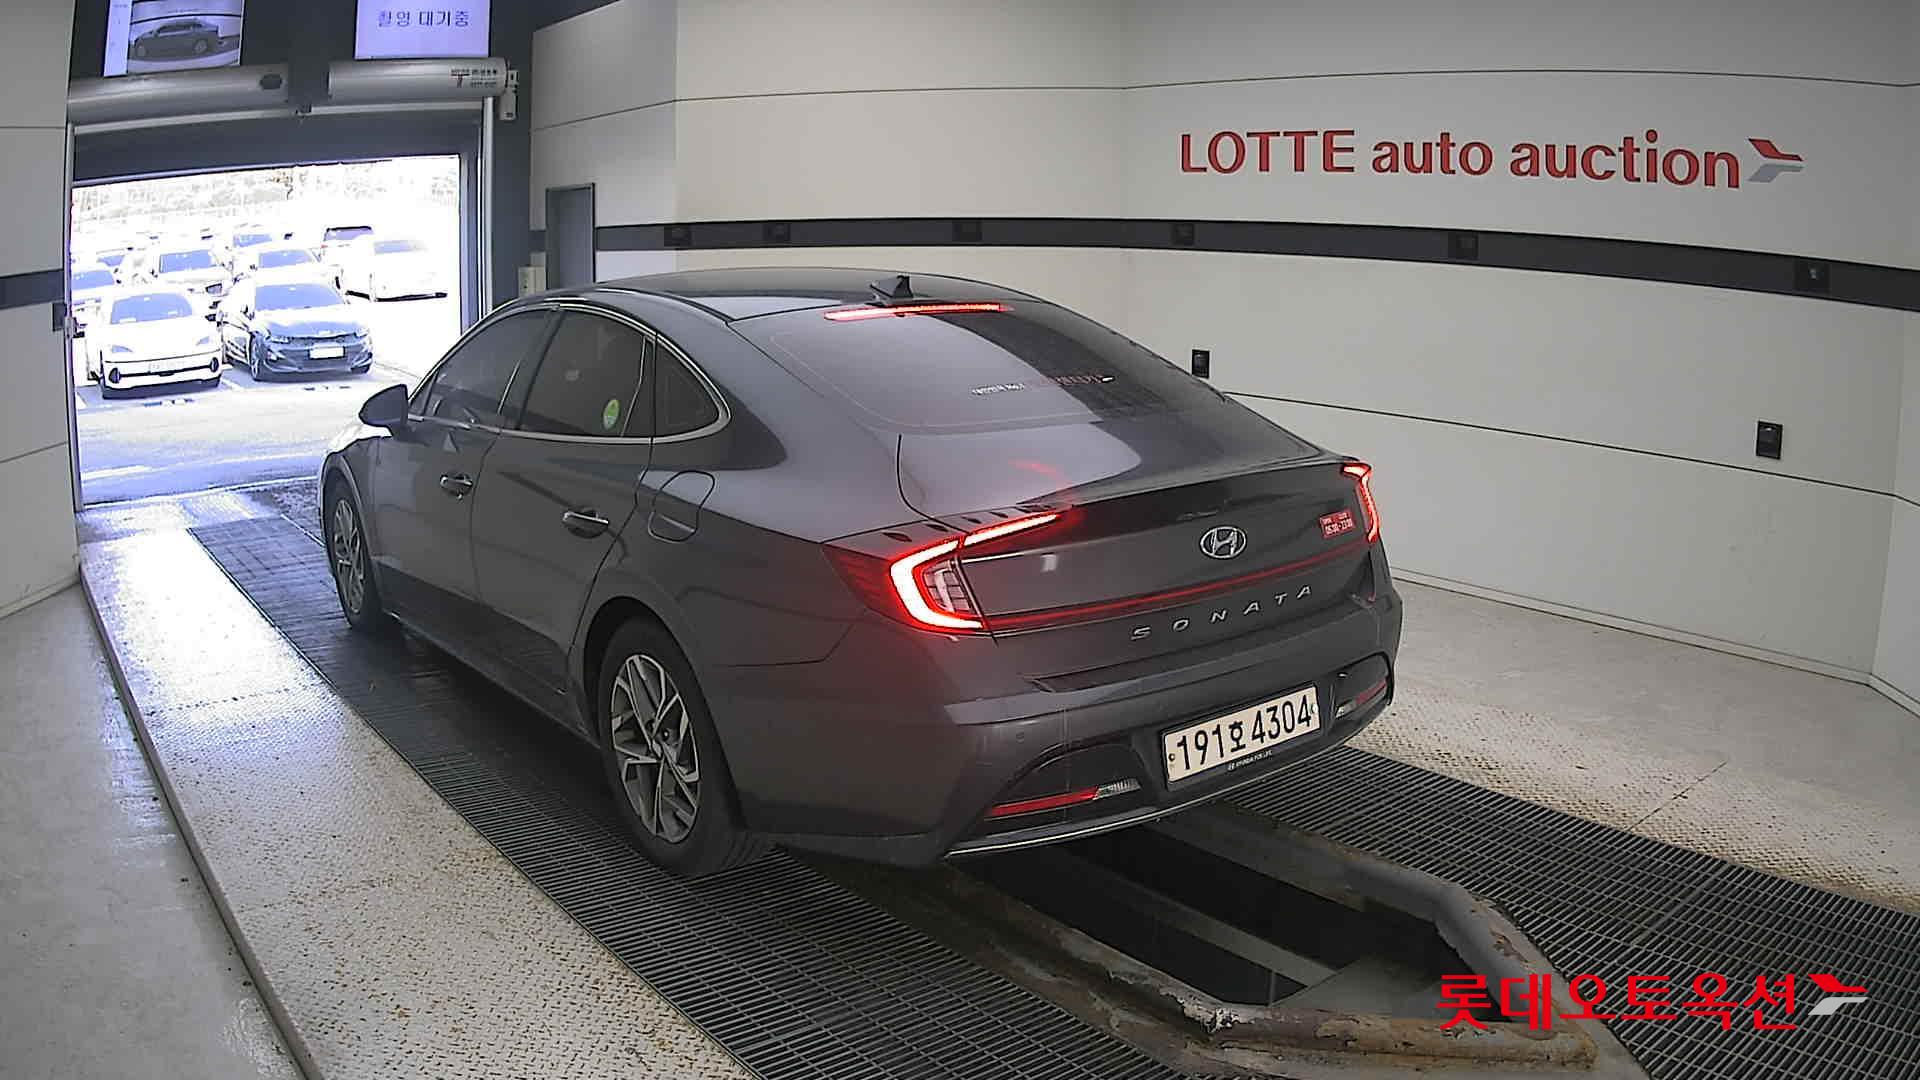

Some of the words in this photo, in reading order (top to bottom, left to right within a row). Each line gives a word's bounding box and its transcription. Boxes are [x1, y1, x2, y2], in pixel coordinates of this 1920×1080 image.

[1180, 129, 1355, 174] LOTTE
[1372, 132, 1493, 176] auto
[1510, 129, 1741, 190] auction
[1130, 585, 1312, 641] SONATA
